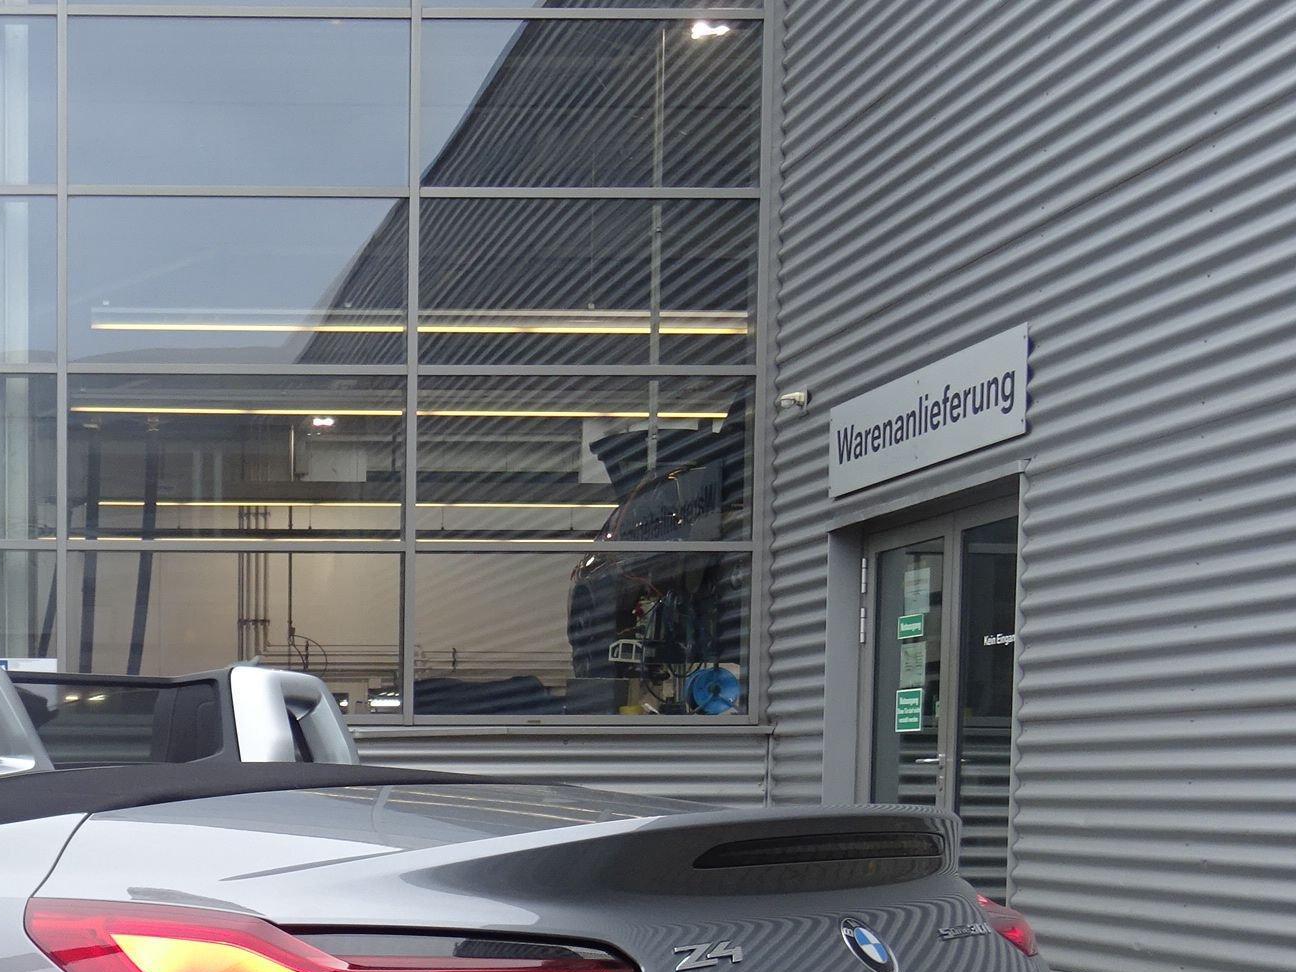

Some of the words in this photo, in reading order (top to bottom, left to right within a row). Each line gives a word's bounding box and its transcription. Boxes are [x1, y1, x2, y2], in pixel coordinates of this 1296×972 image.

[837, 370, 1016, 465] Warenanlieferung
[983, 634, 996, 646] Kein
[672, 940, 744, 972] Z4
